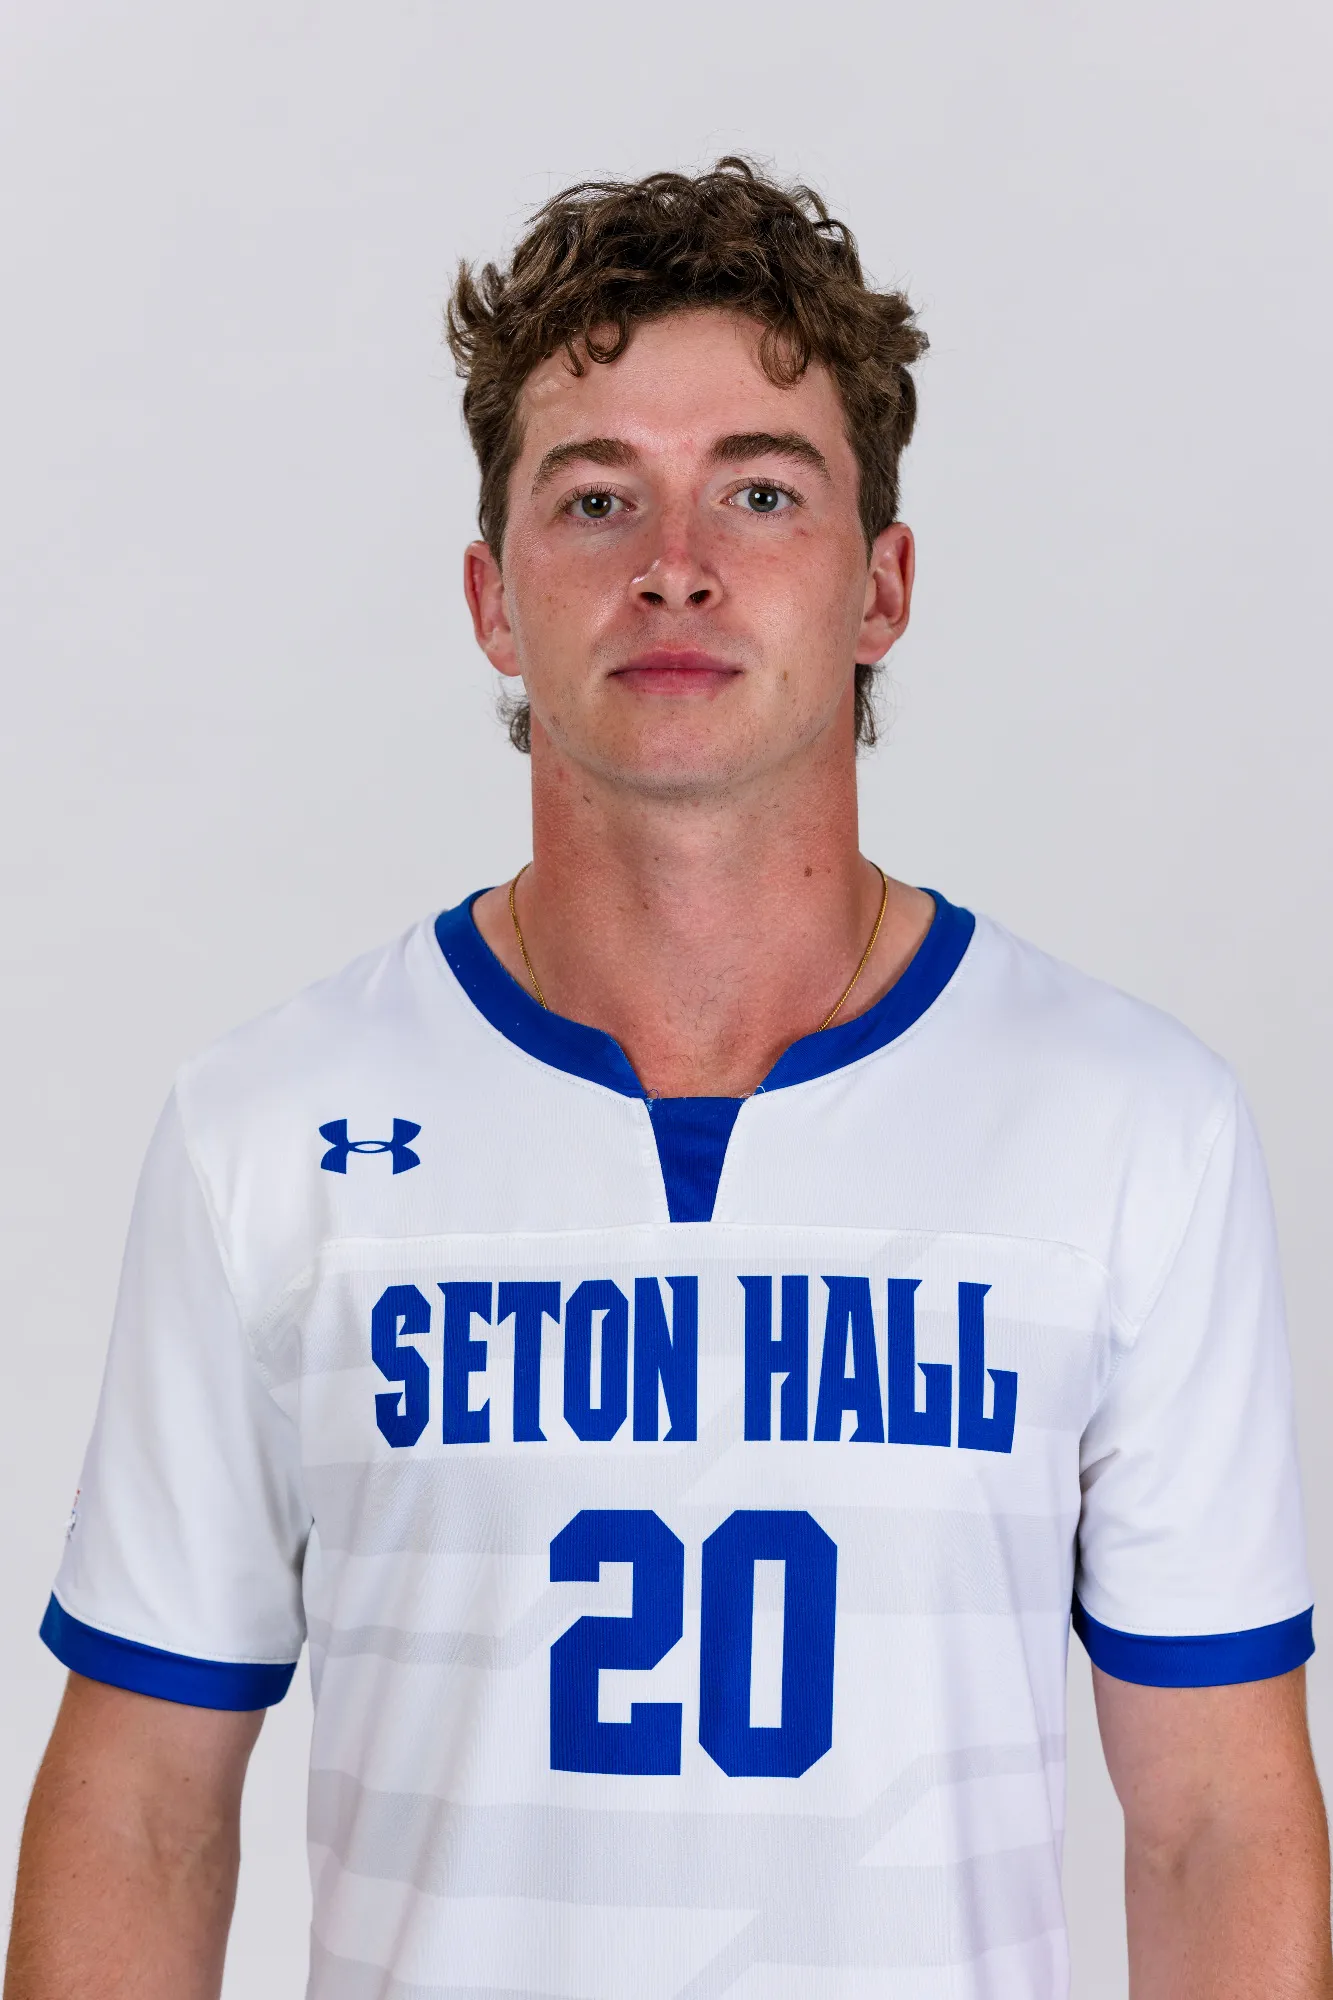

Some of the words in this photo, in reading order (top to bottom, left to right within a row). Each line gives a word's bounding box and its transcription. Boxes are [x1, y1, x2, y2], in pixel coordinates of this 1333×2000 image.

[371, 1276, 698, 1448] SETON
[737, 1275, 1018, 1453] HALL
[550, 1510, 837, 1778] 20
